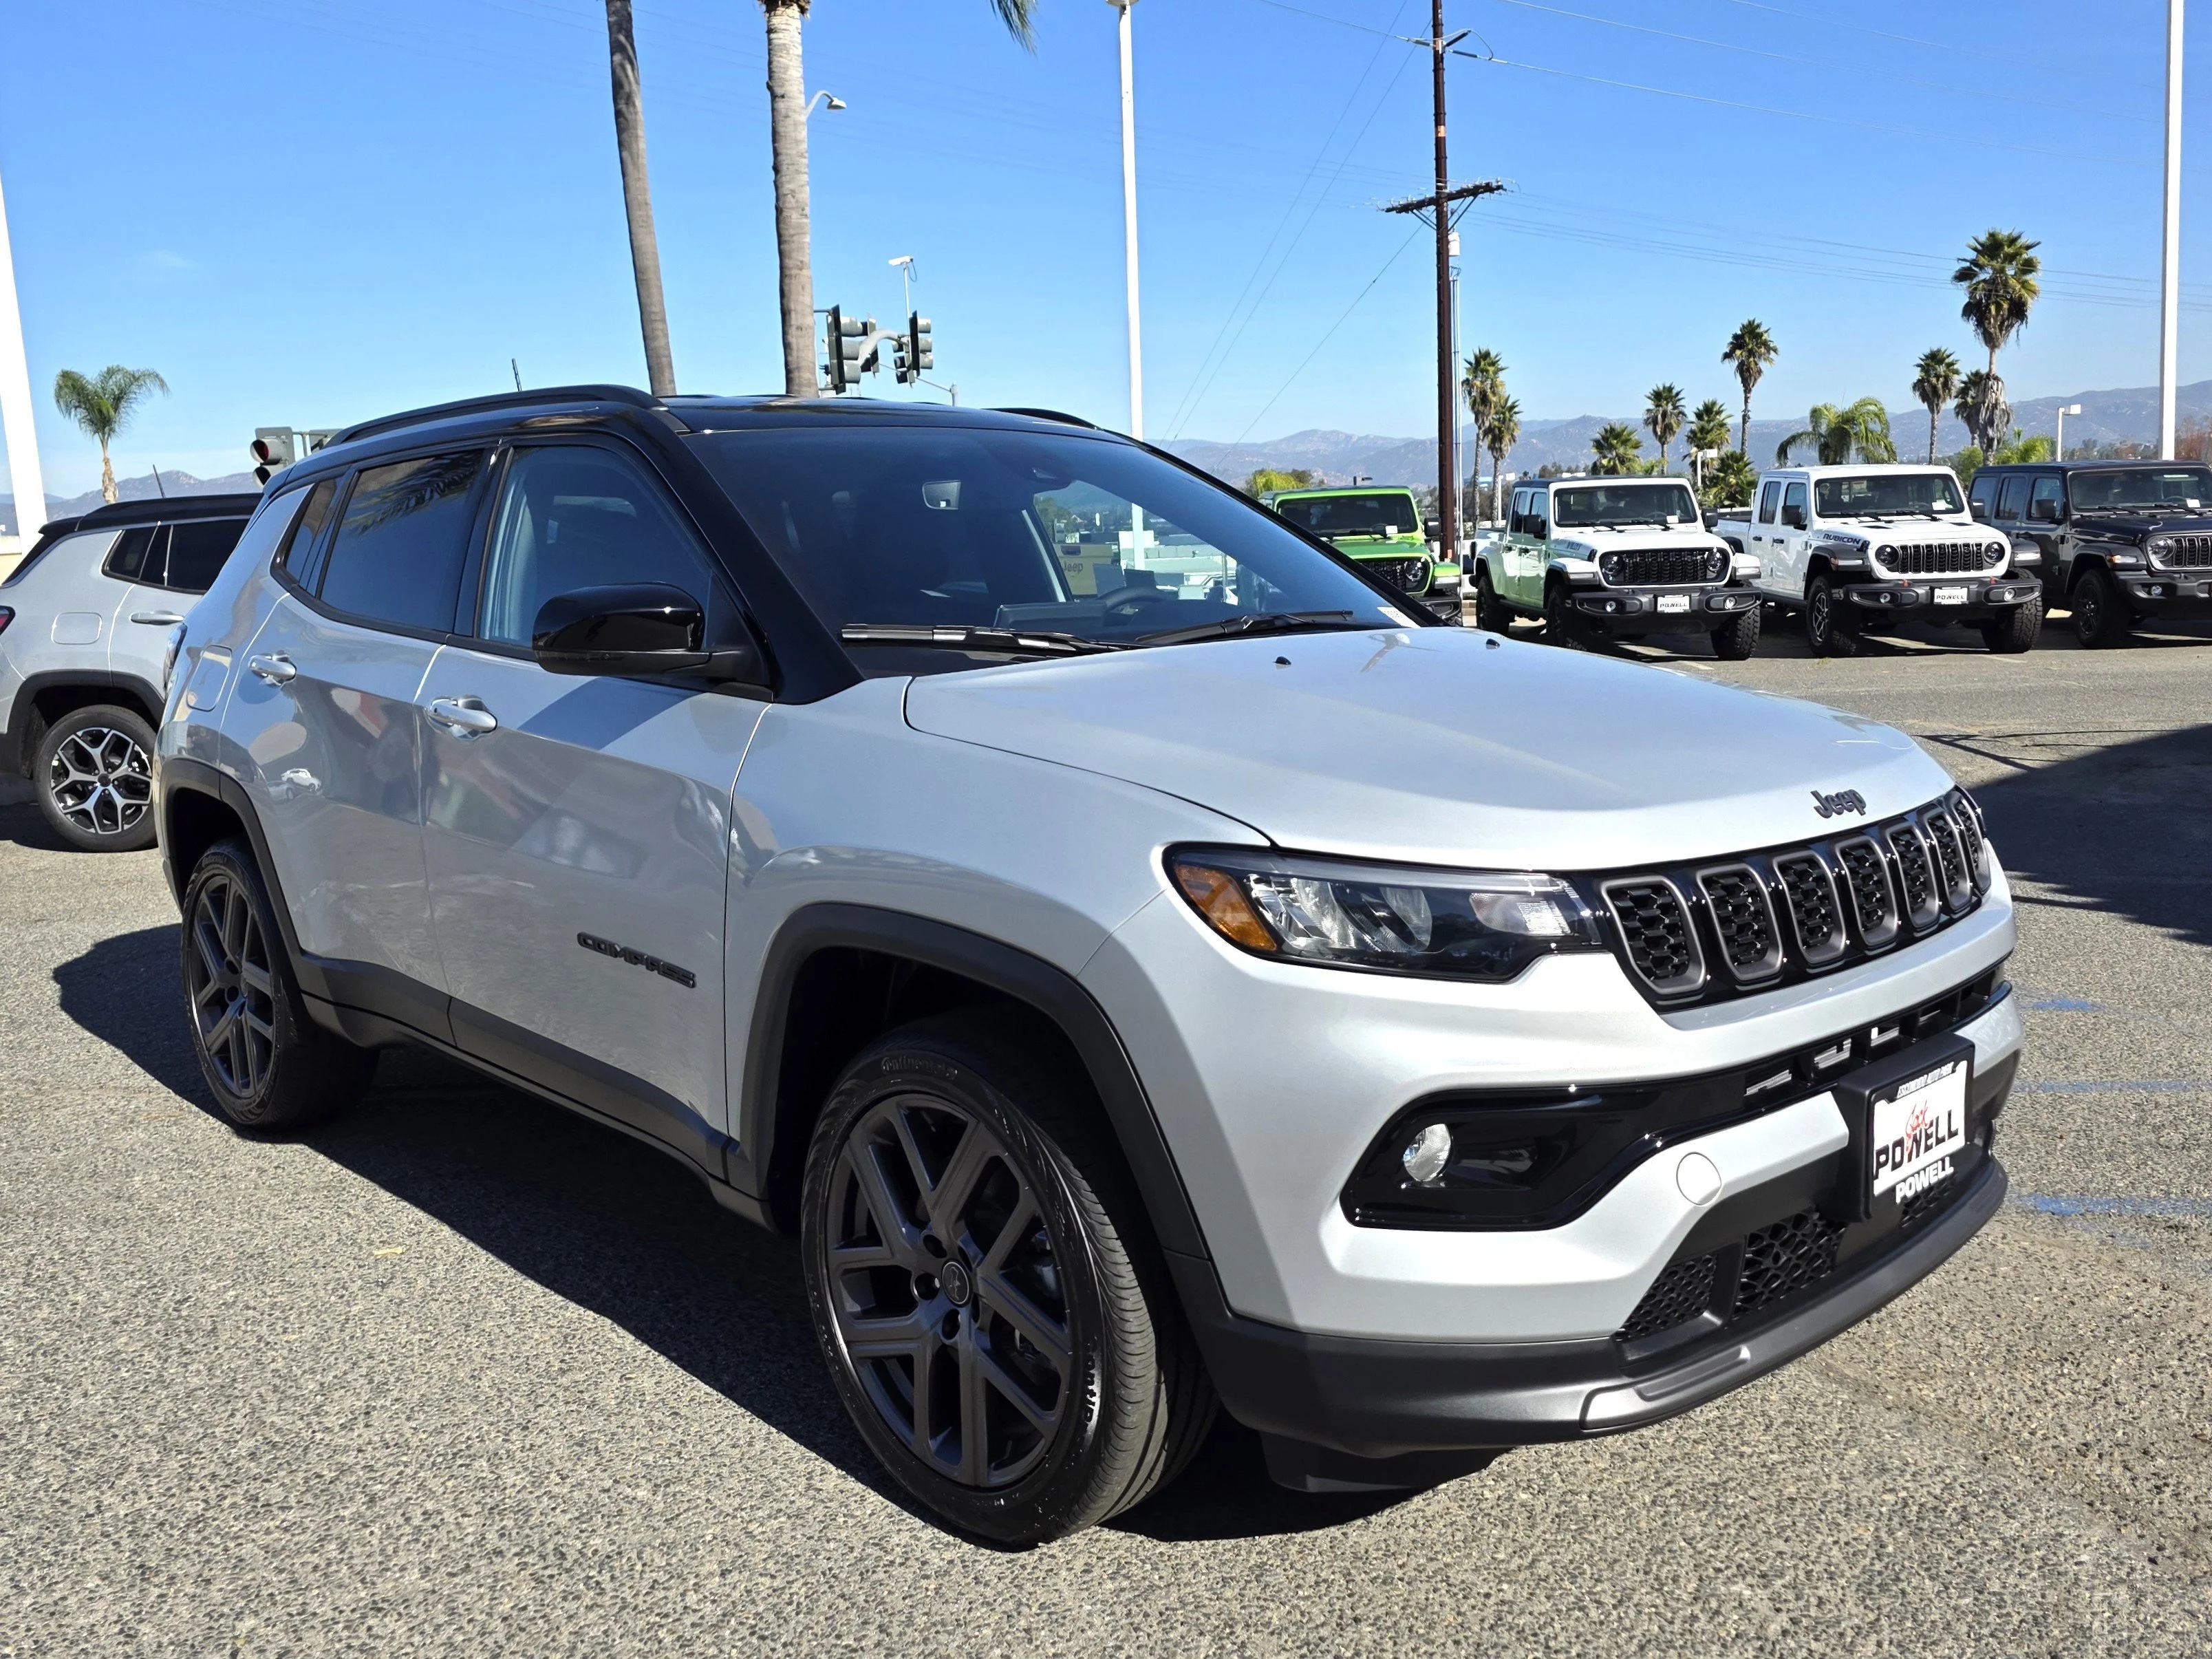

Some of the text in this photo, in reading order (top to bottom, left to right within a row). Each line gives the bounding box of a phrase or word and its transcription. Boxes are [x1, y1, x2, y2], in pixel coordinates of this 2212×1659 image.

[1823, 533, 1860, 544] RUBICON
[1064, 561, 1084, 575] Jeep
[1810, 789, 1867, 819] Jeep
[577, 932, 697, 989] COMPASS
[1873, 1109, 1959, 1181] POWELL
[1896, 1156, 1954, 1204] POWELL
